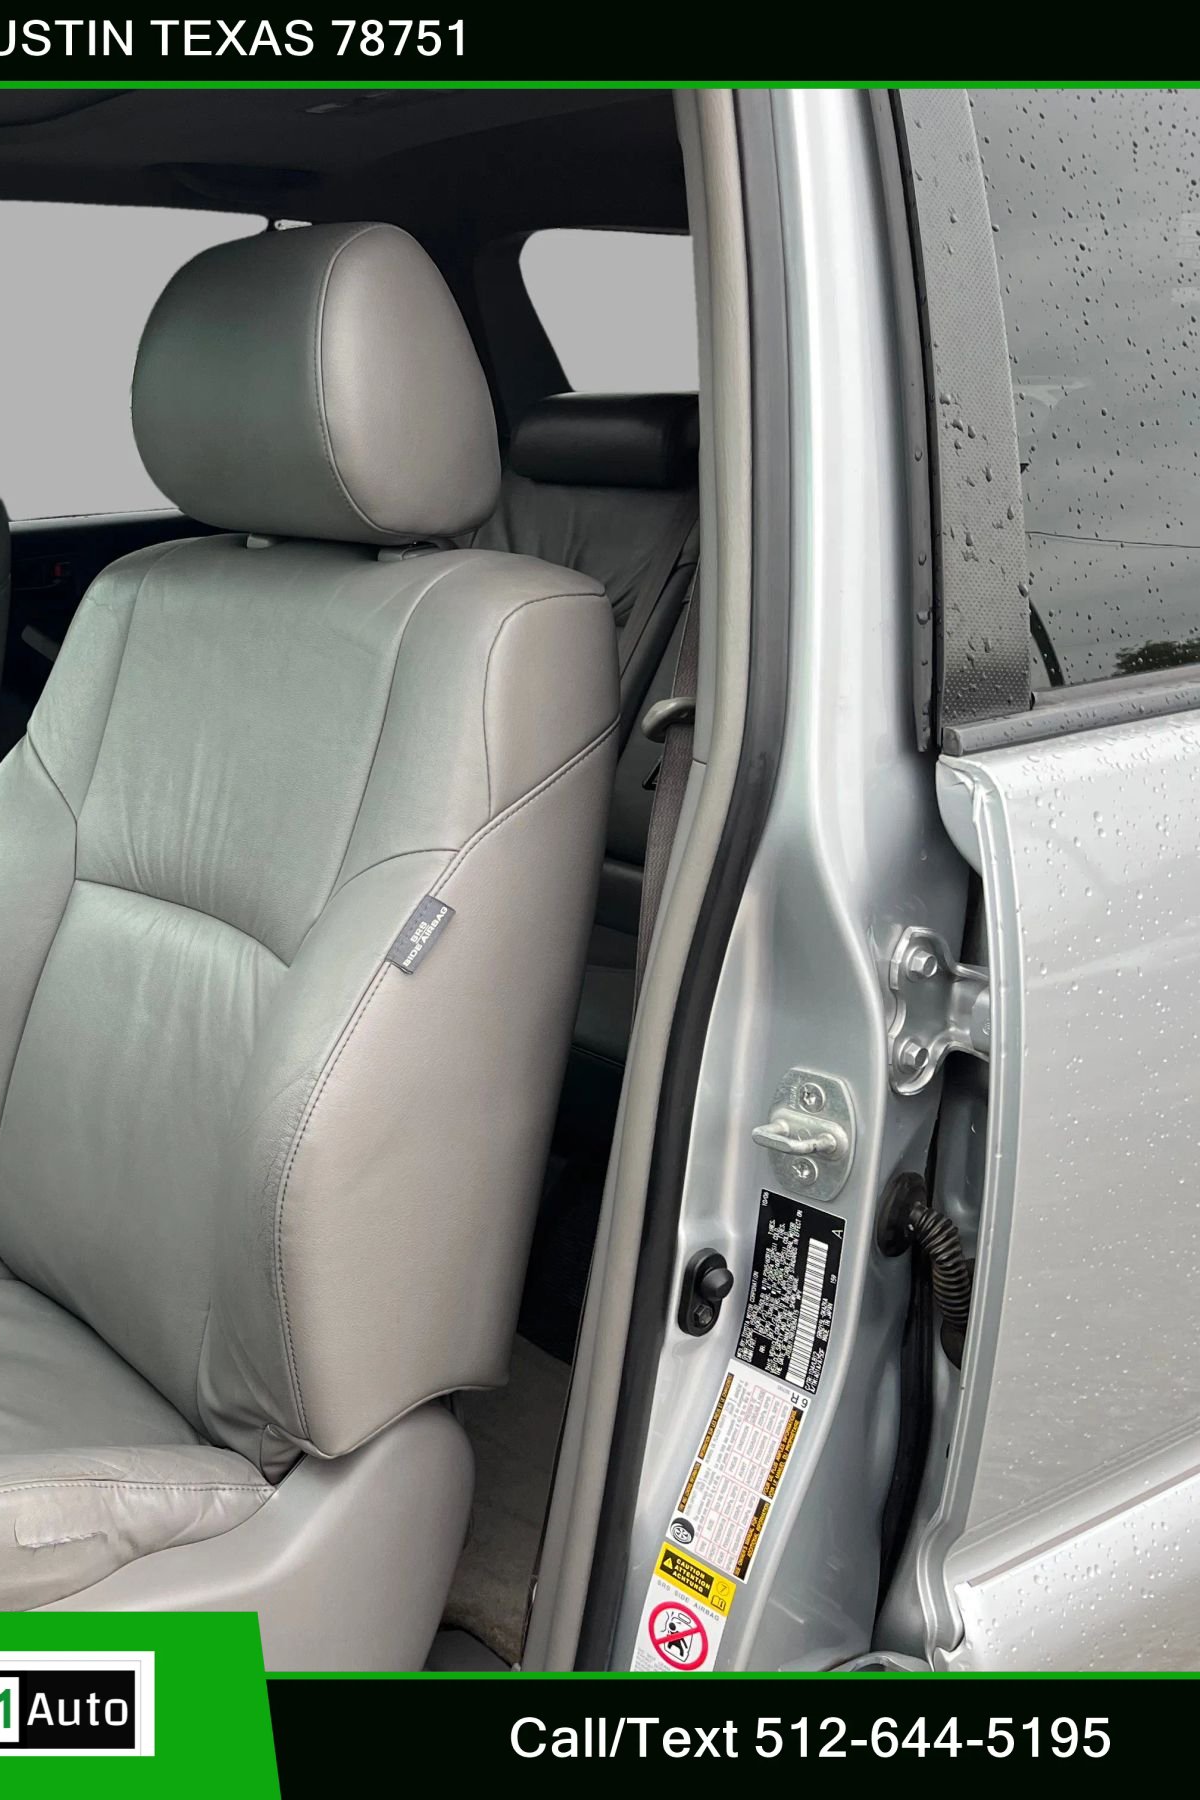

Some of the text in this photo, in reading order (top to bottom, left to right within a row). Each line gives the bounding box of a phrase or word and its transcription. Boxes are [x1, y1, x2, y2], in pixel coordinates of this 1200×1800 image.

[403, 906, 448, 967] SIDE AIRBAG
[832, 1226, 843, 1239] A
[674, 1564, 711, 1590] ATTENTION
[676, 1558, 706, 1579] CAUTION
[672, 1570, 704, 1593] ACHTUNG
[693, 1603, 720, 1622] AIRBAG
